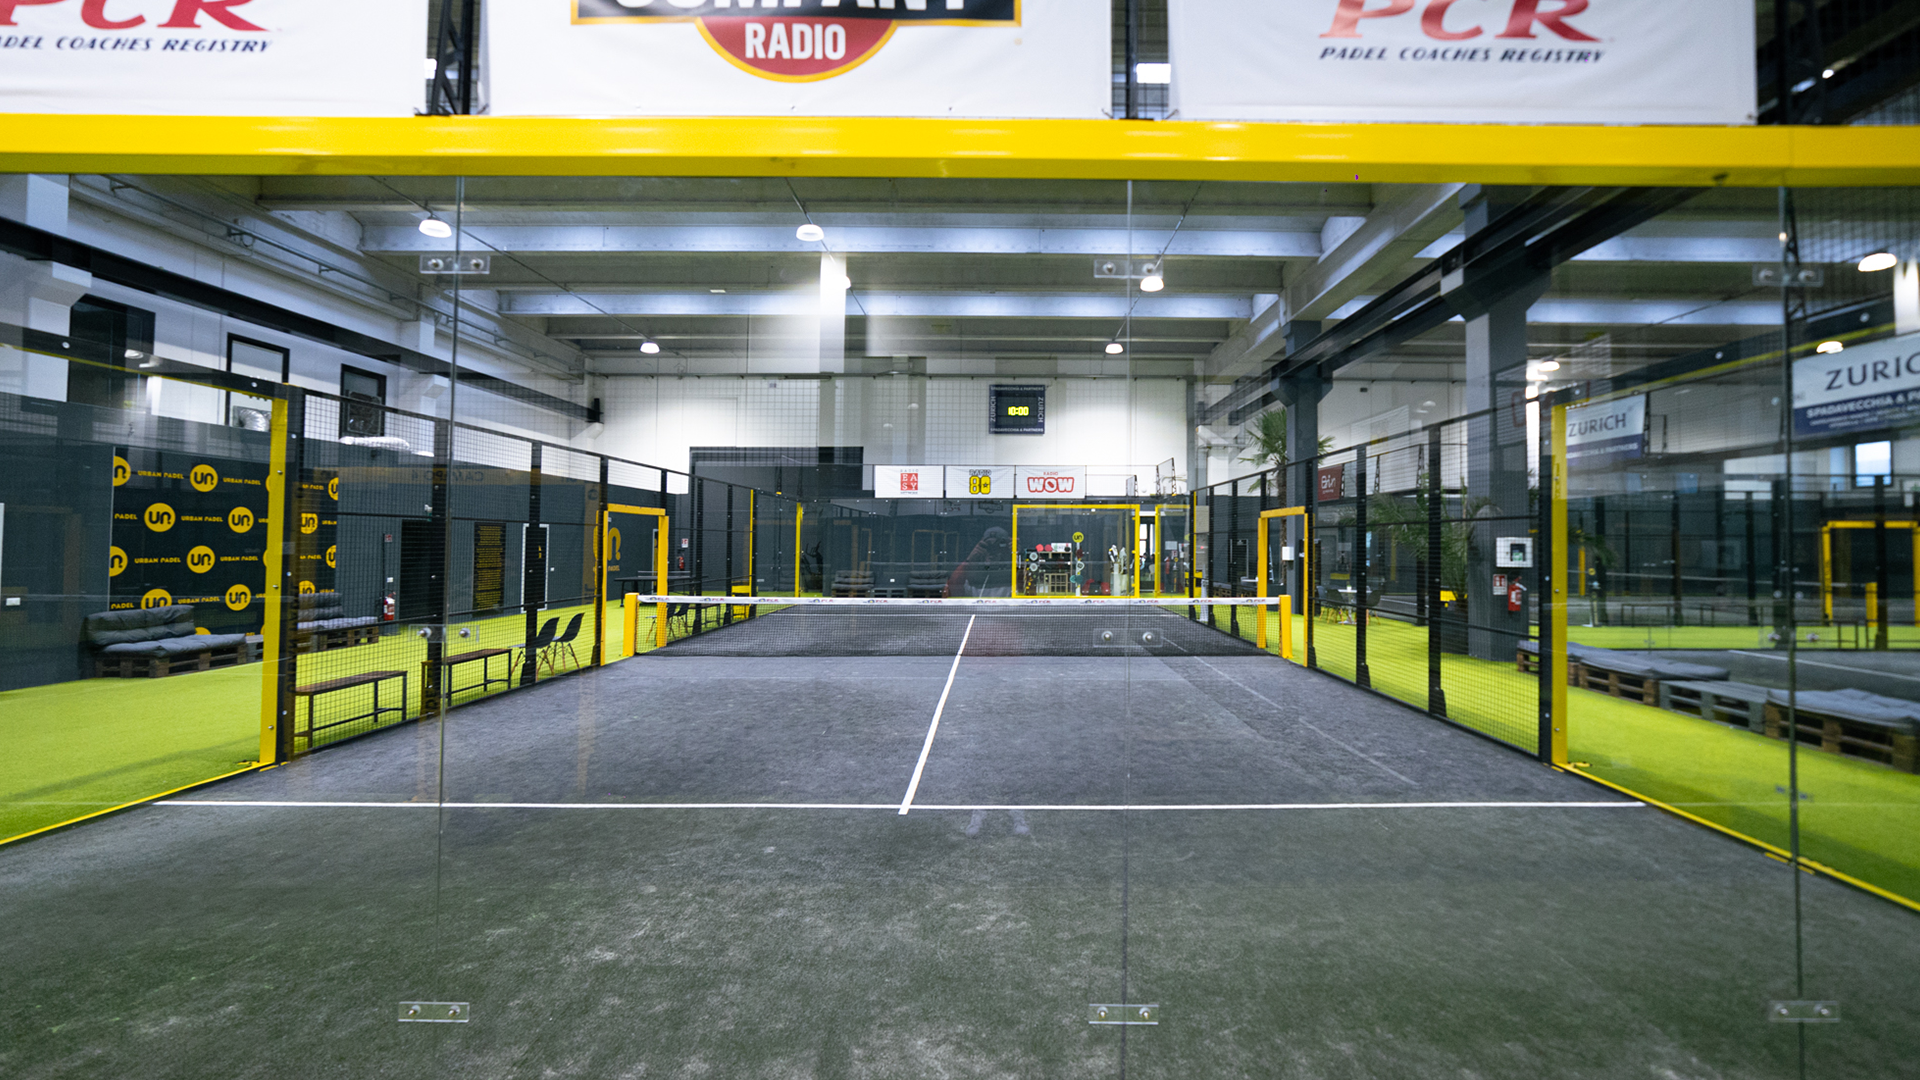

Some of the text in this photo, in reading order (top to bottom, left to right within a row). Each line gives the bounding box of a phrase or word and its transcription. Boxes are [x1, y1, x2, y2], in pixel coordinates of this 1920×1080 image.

[56, 37, 151, 50] COACHES
[162, 39, 272, 52] REGISTRY
[745, 22, 846, 60] RADIO
[1319, 47, 1604, 62] PADEL COACHES REGISTRY
[1008, 406, 1029, 416] 10:00
[1568, 413, 1626, 438] ZURICH
[1027, 477, 1074, 493] WOW
